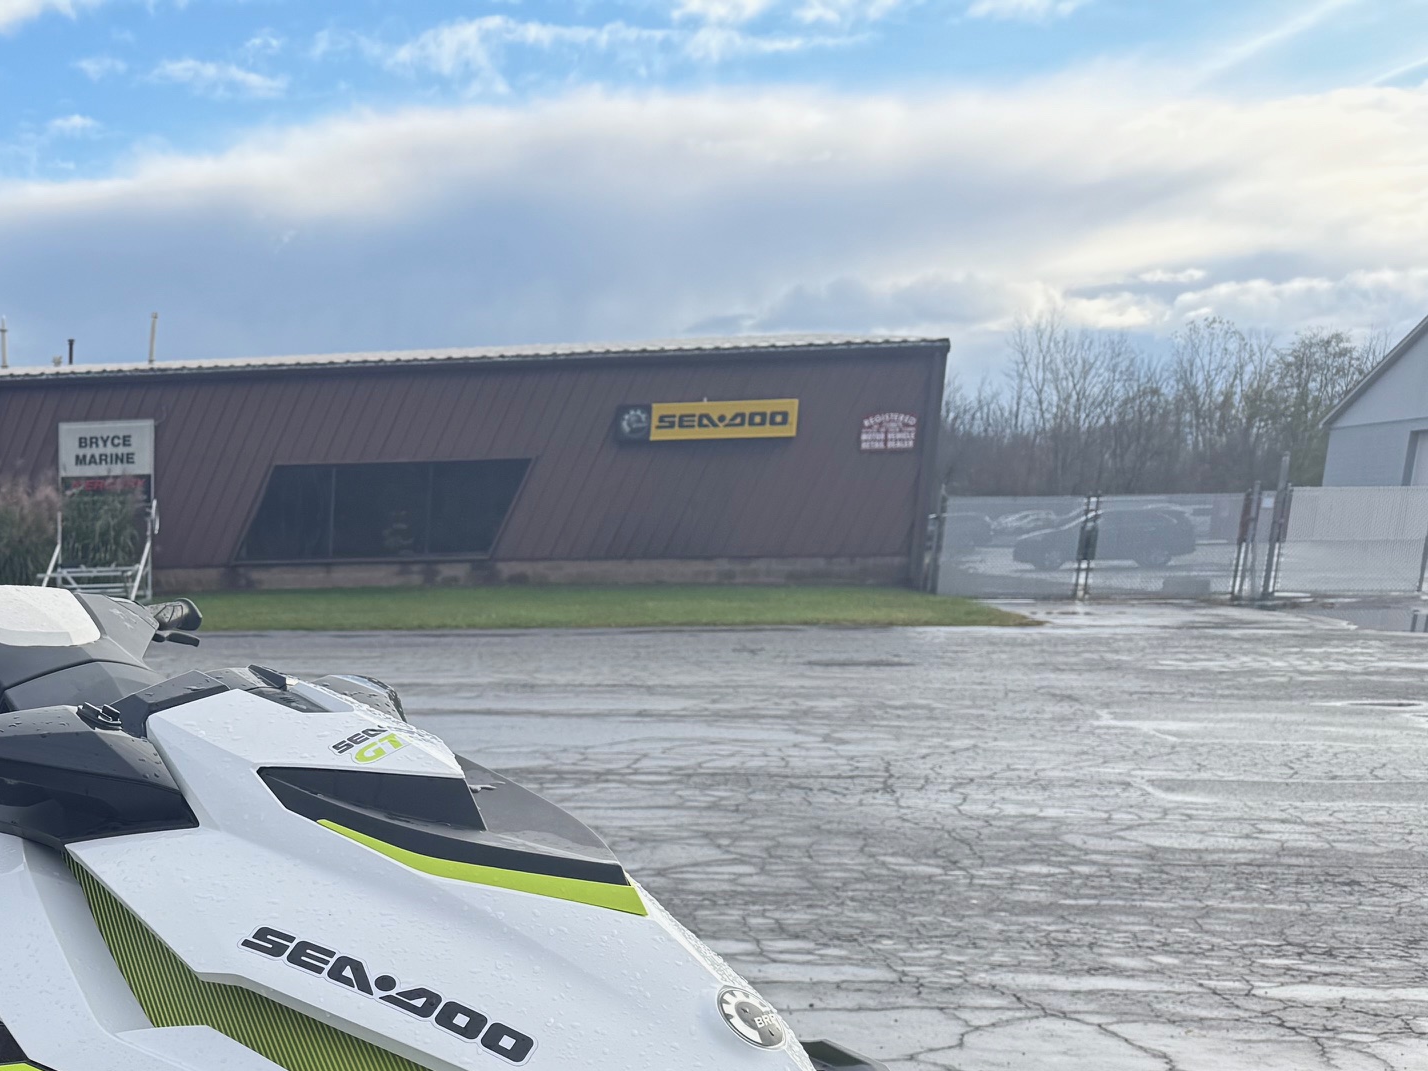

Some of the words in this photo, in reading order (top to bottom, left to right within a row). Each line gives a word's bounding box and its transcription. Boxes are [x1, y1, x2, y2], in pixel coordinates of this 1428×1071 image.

[863, 412, 917, 427] REGISTERED
[78, 434, 133, 449] BRYCE
[74, 452, 135, 466] MARINE
[754, 1012, 778, 1029] BRP
